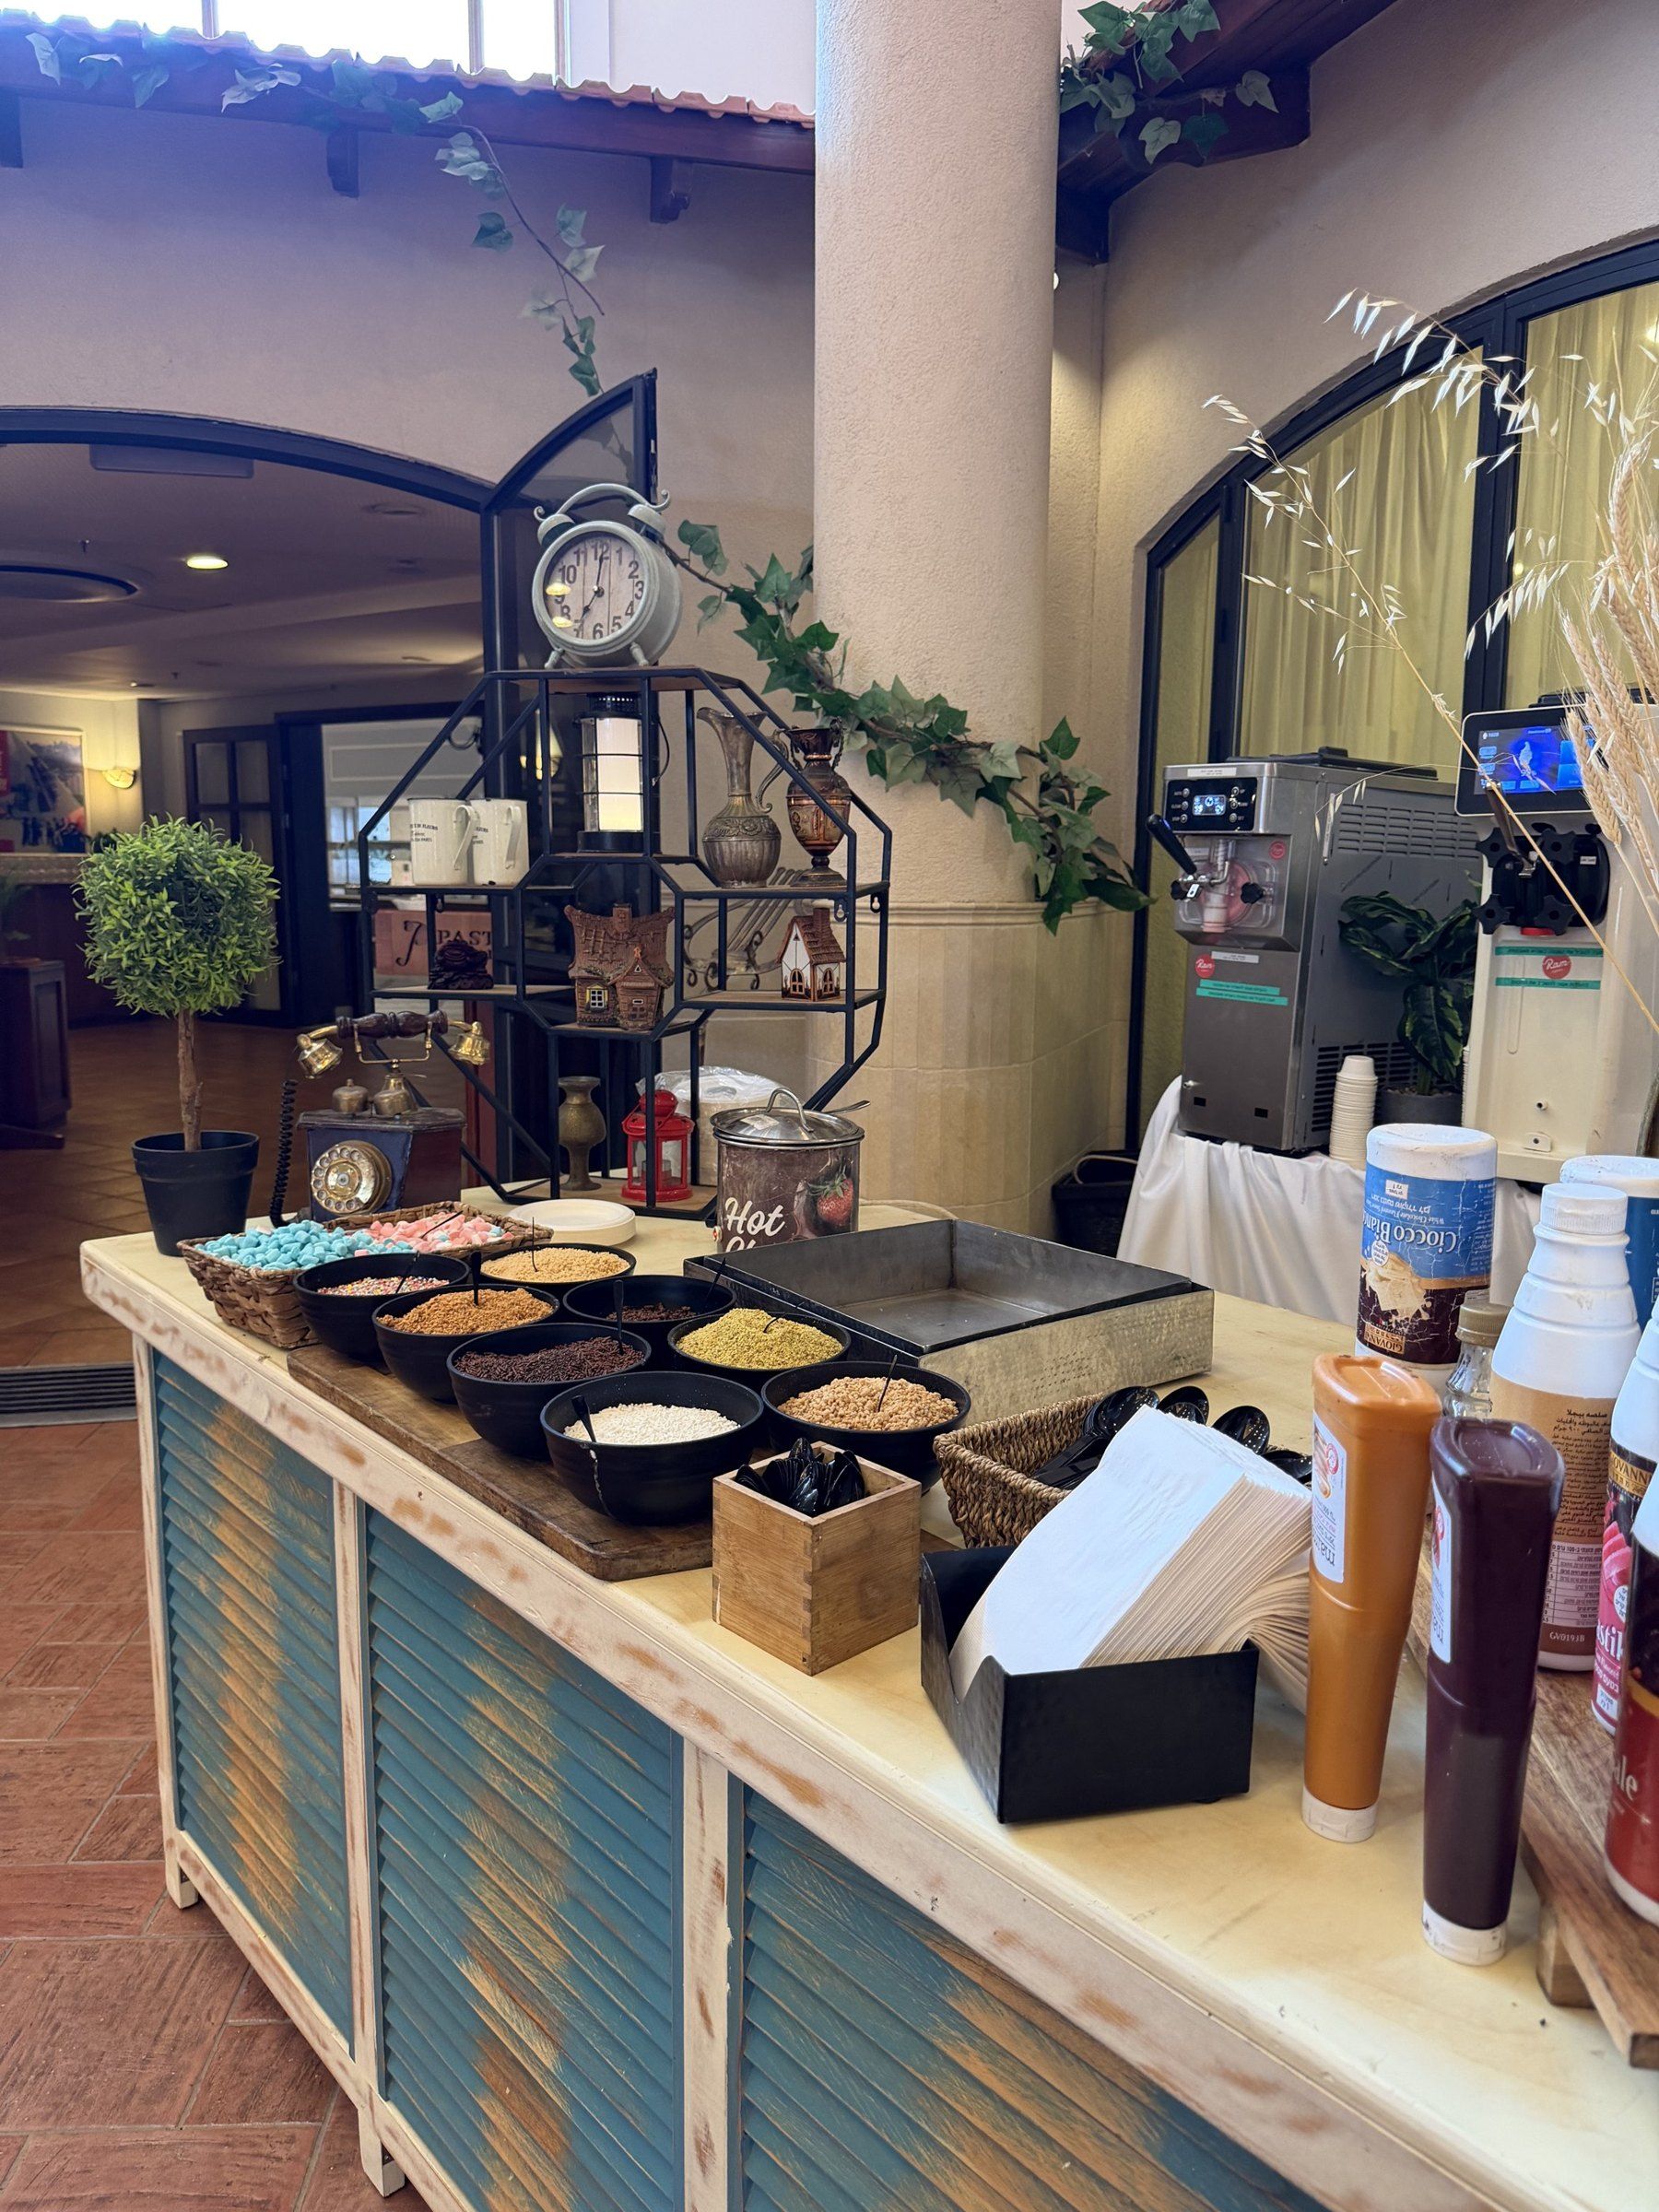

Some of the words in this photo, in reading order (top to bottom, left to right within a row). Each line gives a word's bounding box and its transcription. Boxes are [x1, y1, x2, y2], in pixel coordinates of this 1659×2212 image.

[573, 548, 588, 566] 11
[591, 541, 609, 560] 12
[616, 547, 623, 566] 1
[559, 564, 577, 583] 10
[628, 560, 640, 579] 2
[634, 581, 644, 599] 3
[560, 605, 571, 619] 8
[625, 601, 634, 618] 4
[593, 623, 604, 640] 6
[611, 616, 622, 631] 5
[724, 1196, 785, 1236] Hot
[1393, 1225, 1457, 1253] Ciocco
